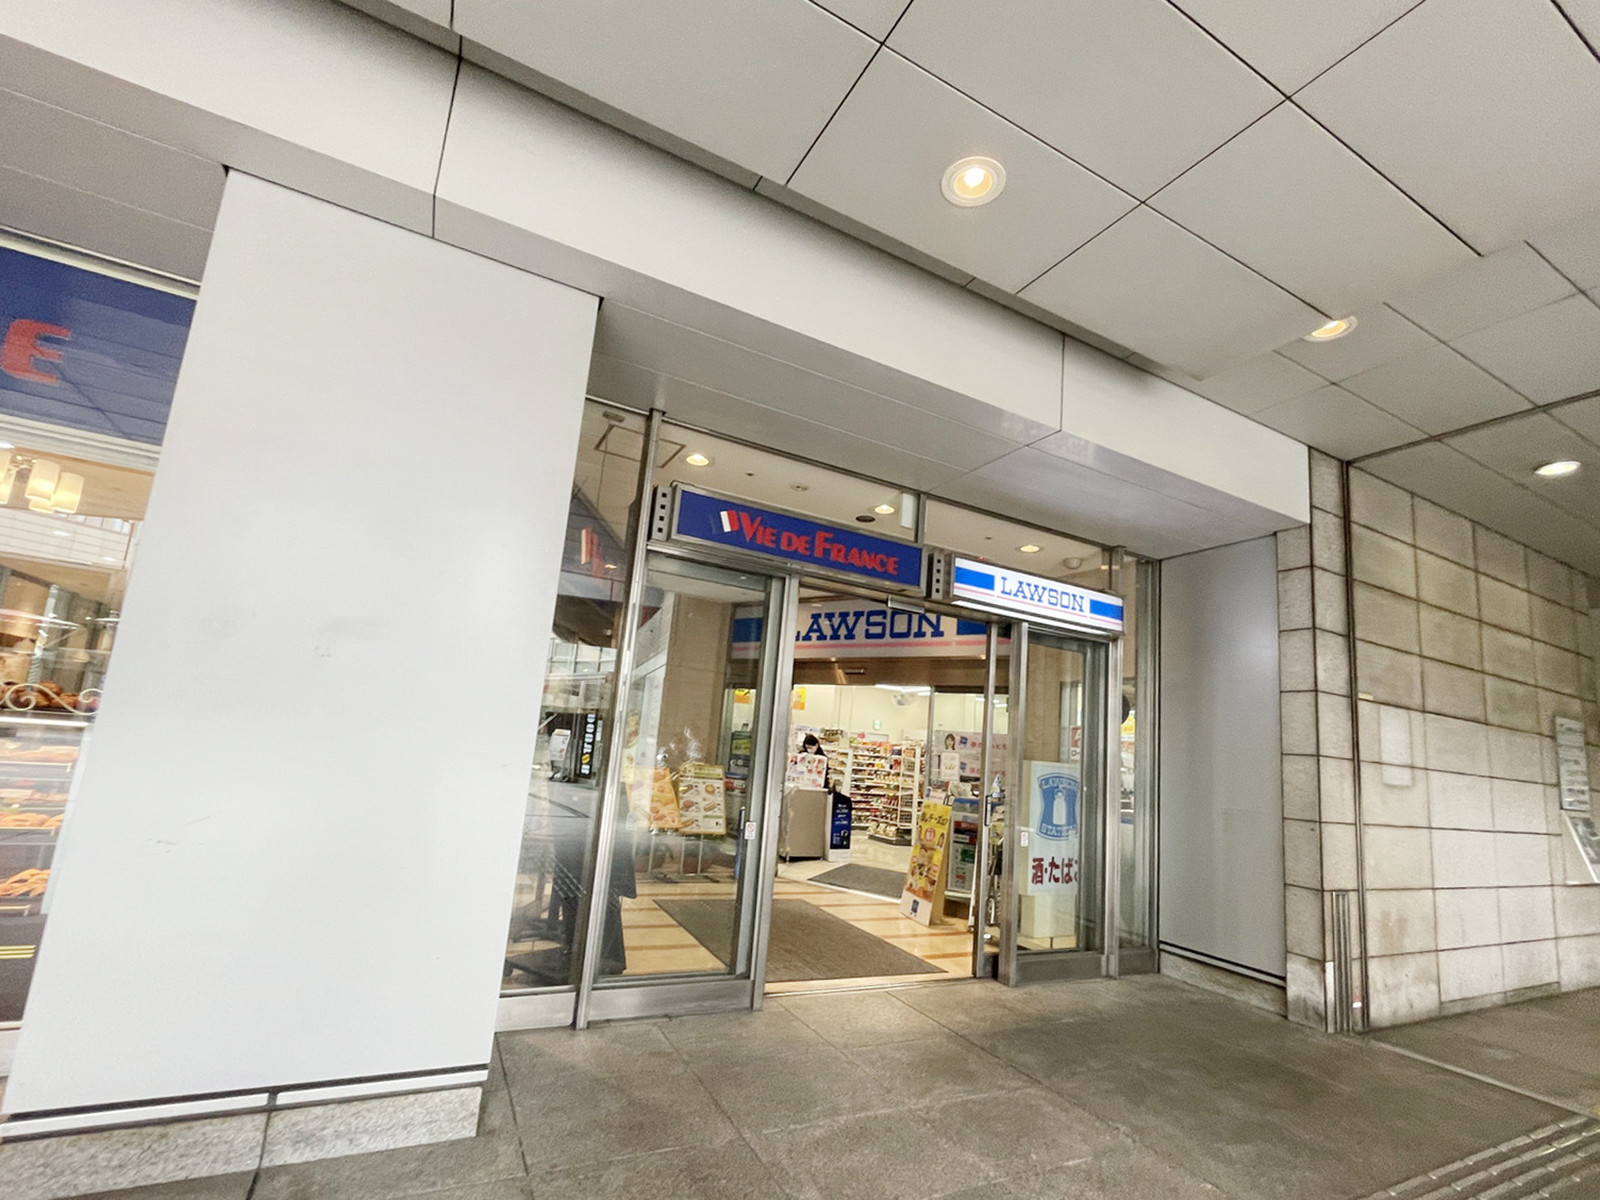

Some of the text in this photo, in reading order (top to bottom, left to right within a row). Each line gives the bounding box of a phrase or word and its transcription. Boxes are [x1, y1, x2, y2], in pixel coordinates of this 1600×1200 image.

[739, 511, 899, 575] VIE DE FRANCE
[1000, 576, 1085, 613] LAWSON
